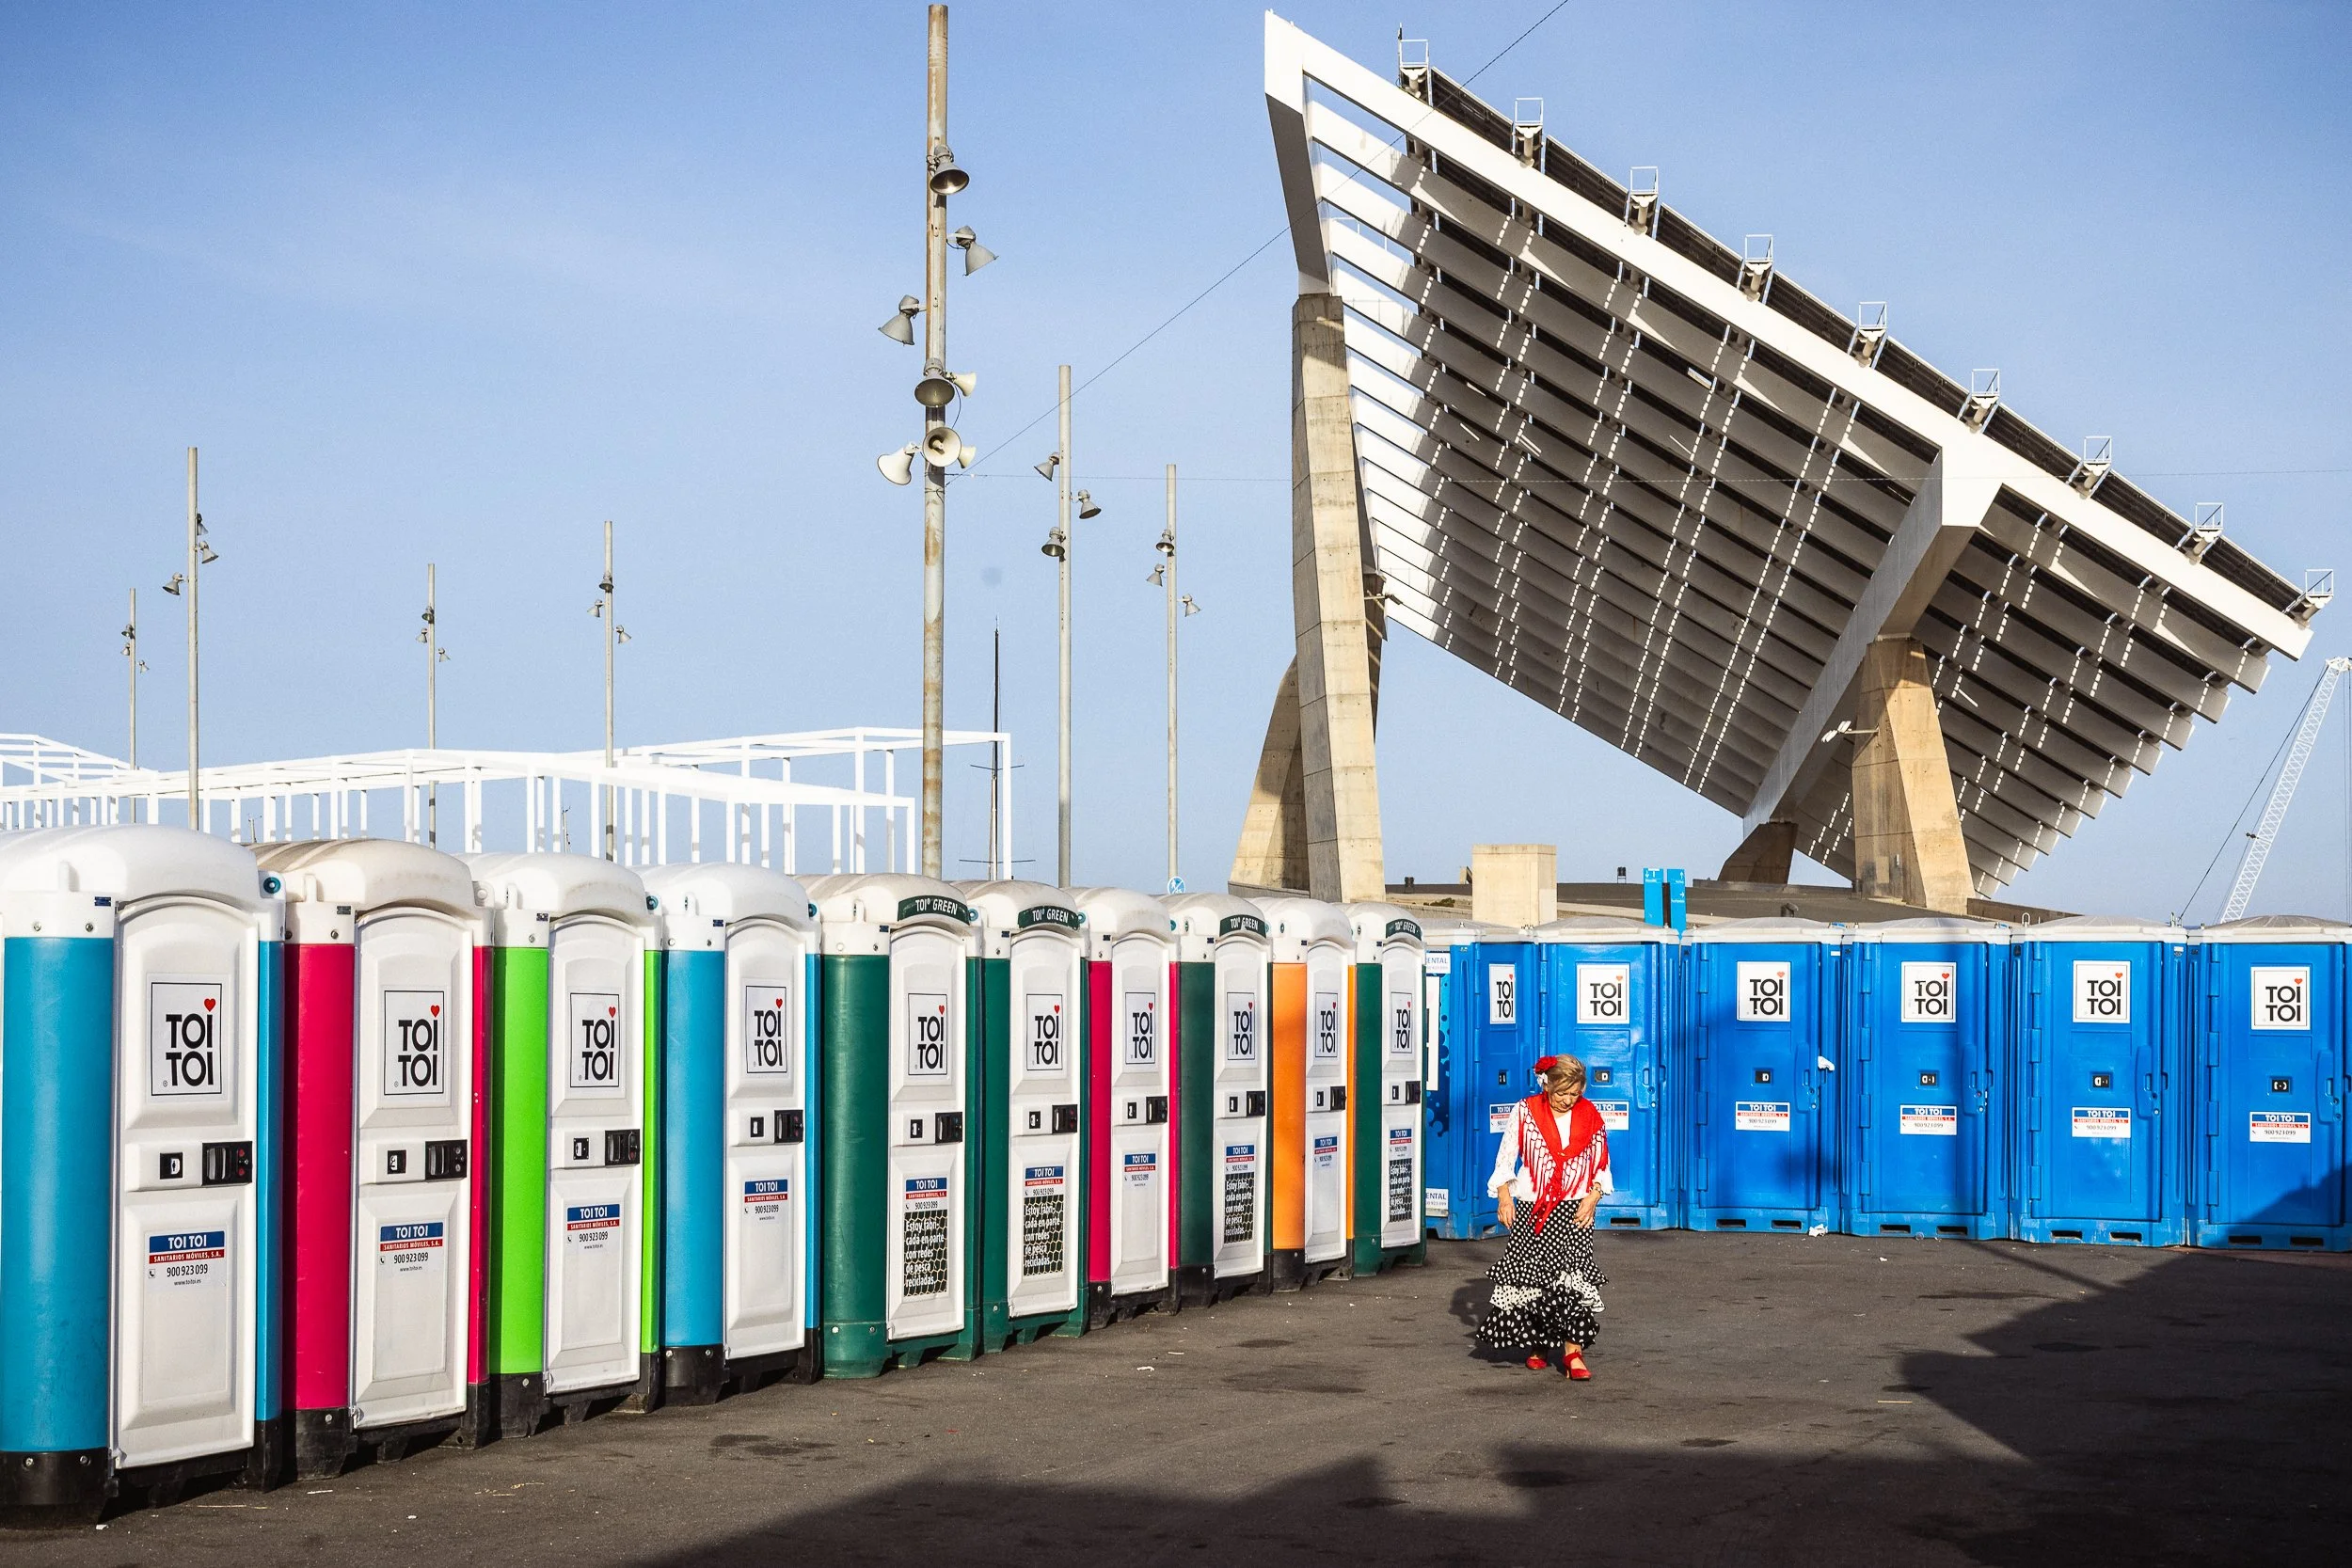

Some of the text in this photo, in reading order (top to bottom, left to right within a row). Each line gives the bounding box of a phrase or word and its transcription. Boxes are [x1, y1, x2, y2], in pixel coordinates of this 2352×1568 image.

[932, 898, 958, 915] GREEN
[1046, 909, 1069, 923] GREEN
[1242, 917, 1258, 930] GREEN
[1497, 981, 1513, 999] TOI
[1590, 983, 1621, 998] TOI
[1750, 979, 1783, 996] TOI
[1915, 980, 1947, 997] TOI
[2088, 980, 2121, 997] TOI
[2265, 986, 2300, 1003] TOI
[1497, 1000, 1513, 1018] TOI
[1590, 1000, 1621, 1016] TOI
[1750, 997, 1783, 1015] TOI
[1915, 998, 1947, 1015] TOI
[2088, 998, 2121, 1015] TOI
[2265, 1005, 2300, 1022] TOI
[755, 1010, 781, 1037] TOI
[1035, 1015, 1058, 1038] TOI
[1133, 1012, 1152, 1035] TOI
[1234, 1011, 1251, 1032] TOI
[1321, 1010, 1335, 1031] TOI
[1396, 1009, 1410, 1028] TOI
[166, 1013, 213, 1049] TOI
[398, 1019, 437, 1052] TOI
[581, 1019, 614, 1049] TOI
[918, 1016, 944, 1041] TOI
[1133, 1036, 1152, 1058] TOI
[1234, 1034, 1252, 1054] TOI
[1321, 1032, 1335, 1053] TOI
[1396, 1029, 1410, 1049] TOI
[755, 1039, 783, 1067] TOI
[917, 1043, 943, 1069] TOI
[1034, 1040, 1058, 1065] TOI
[166, 1051, 214, 1086] TOI
[398, 1053, 437, 1086] TOI
[581, 1051, 613, 1081] TOI
[1035, 1167, 1054, 1177] TOI TOI
[755, 1181, 777, 1192] TOI TOI
[916, 1180, 937, 1189] TOI TOI
[580, 1207, 607, 1219] TOI TOI
[1025, 1206, 1039, 1217] Estoy
[905, 1221, 922, 1233] Estoy
[1025, 1217, 1037, 1228] cada
[1046, 1216, 1059, 1228] parte
[396, 1225, 428, 1238] TOI TOI
[579, 1231, 608, 1242] 900 923 099
[906, 1233, 919, 1245] cada
[930, 1232, 944, 1245] parte
[1025, 1229, 1049, 1242] con redes
[168, 1234, 207, 1249] TOI TOI
[1025, 1244, 1047, 1255] de pesca
[154, 1254, 184, 1262] SANITARIOS
[186, 1251, 210, 1259] MÓVILES,
[393, 1252, 428, 1263] 900 923 099
[906, 1246, 933, 1259] con redes
[167, 1263, 208, 1276] 900 923 099
[905, 1262, 930, 1275] de pesca
